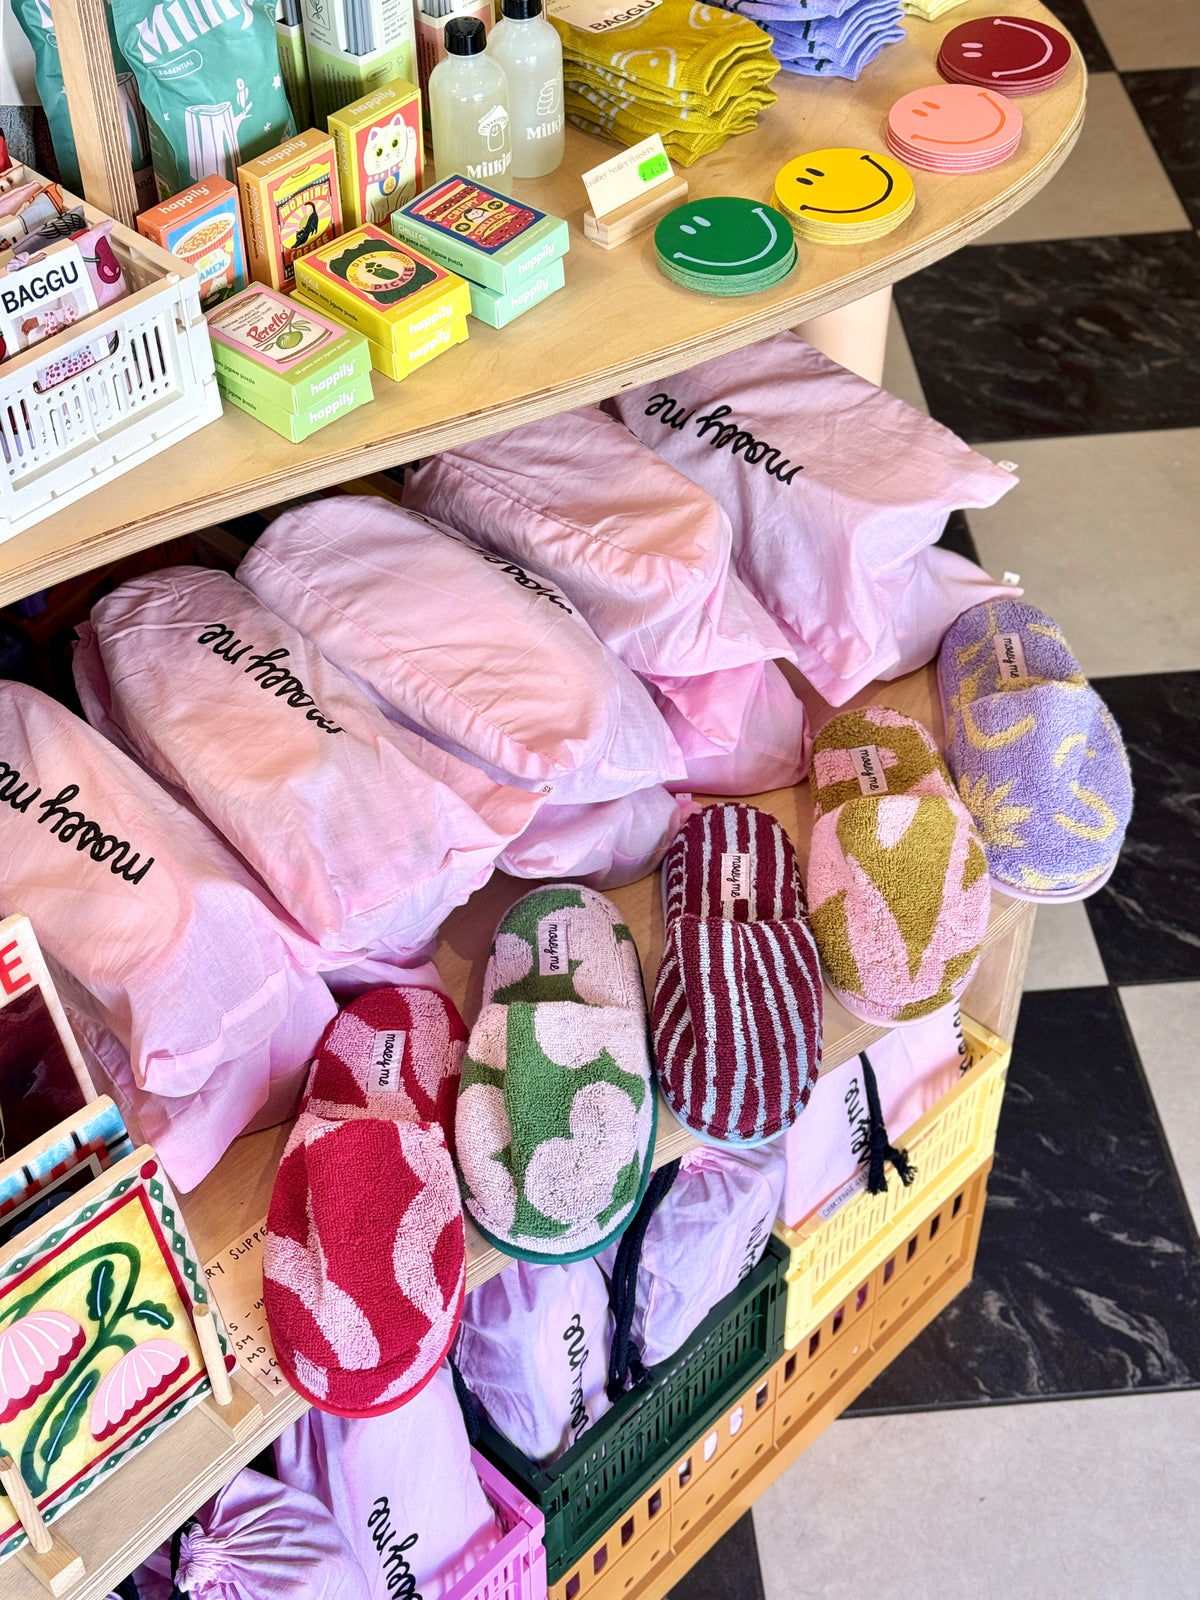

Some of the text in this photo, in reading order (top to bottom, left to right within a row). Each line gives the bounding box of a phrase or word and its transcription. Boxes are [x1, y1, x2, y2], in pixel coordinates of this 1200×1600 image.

[589, 0, 656, 31] BAGGU
[348, 88, 397, 115] happily
[256, 139, 308, 166] happily
[158, 185, 210, 215] happily
[280, 184, 329, 219] MORNING
[447, 197, 479, 220] CRISPY
[397, 225, 430, 245] CHILLI OIL
[475, 215, 496, 236] CHILLI
[495, 210, 511, 224] OIL
[290, 234, 330, 262] COFFEE
[353, 253, 377, 268] DILL
[447, 254, 464, 268] puzzle
[518, 243, 556, 274] happily
[199, 260, 226, 281] AMEN
[373, 266, 415, 290] PICKLE
[0, 261, 79, 314] BAGGU
[510, 278, 550, 309] happily
[246, 310, 289, 343] Perello
[343, 308, 359, 323] puzzle
[409, 304, 453, 336] happily
[408, 330, 450, 362] happily
[311, 361, 355, 396] happily
[309, 391, 355, 424] happily
[645, 393, 804, 485] mosey me
[197, 623, 254, 665] me
[868, 776, 879, 791] me
[37, 784, 155, 885] mosey
[543, 923, 560, 972] mosey me
[376, 1033, 396, 1087] mosey me
[844, 1078, 864, 1126] me
[206, 1225, 269, 1281] RY SLIPPE
[235, 1334, 254, 1351] SM
[246, 1346, 266, 1364] MD
[367, 1496, 396, 1556] me
